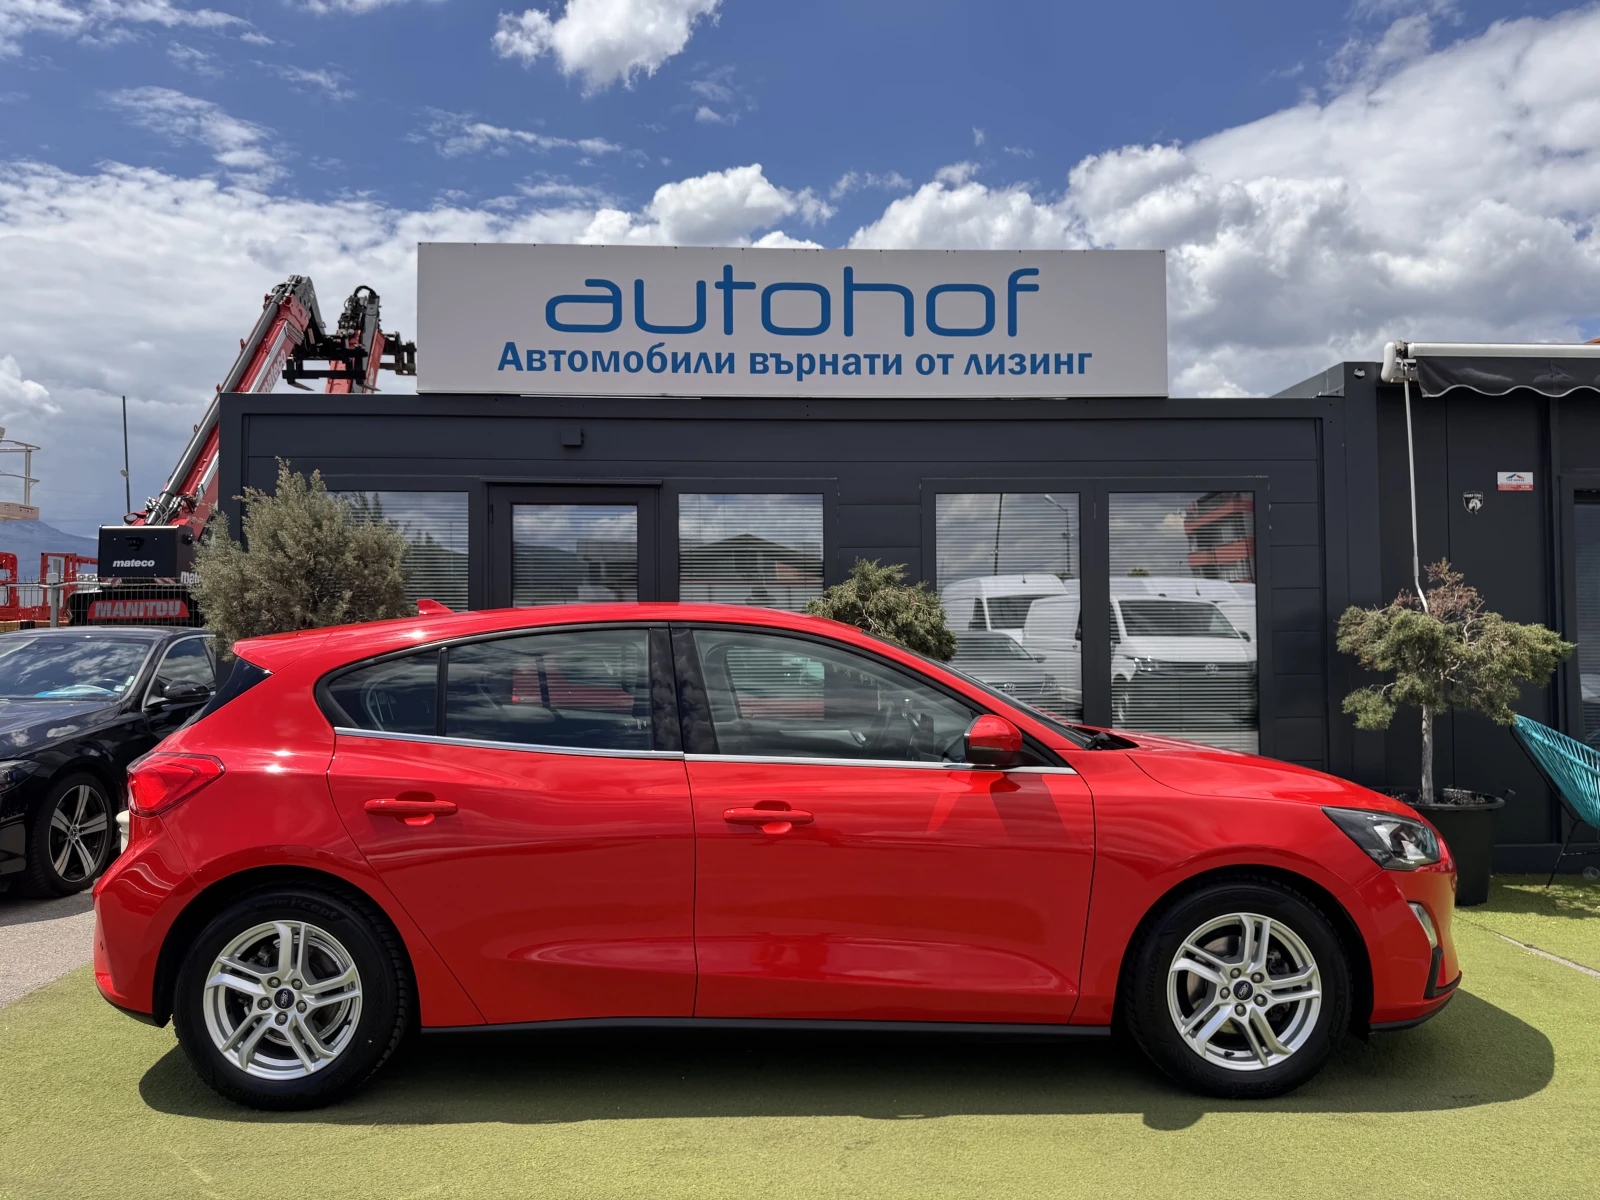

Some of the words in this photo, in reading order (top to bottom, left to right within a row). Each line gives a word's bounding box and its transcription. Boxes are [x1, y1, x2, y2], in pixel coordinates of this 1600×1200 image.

[545, 264, 1039, 337] autohof
[497, 341, 735, 374] Автомобили
[749, 351, 902, 382] върнати
[915, 353, 954, 375] от
[963, 352, 1092, 375] лизинг
[112, 559, 155, 568] mateco
[94, 600, 181, 617] MANITOU
